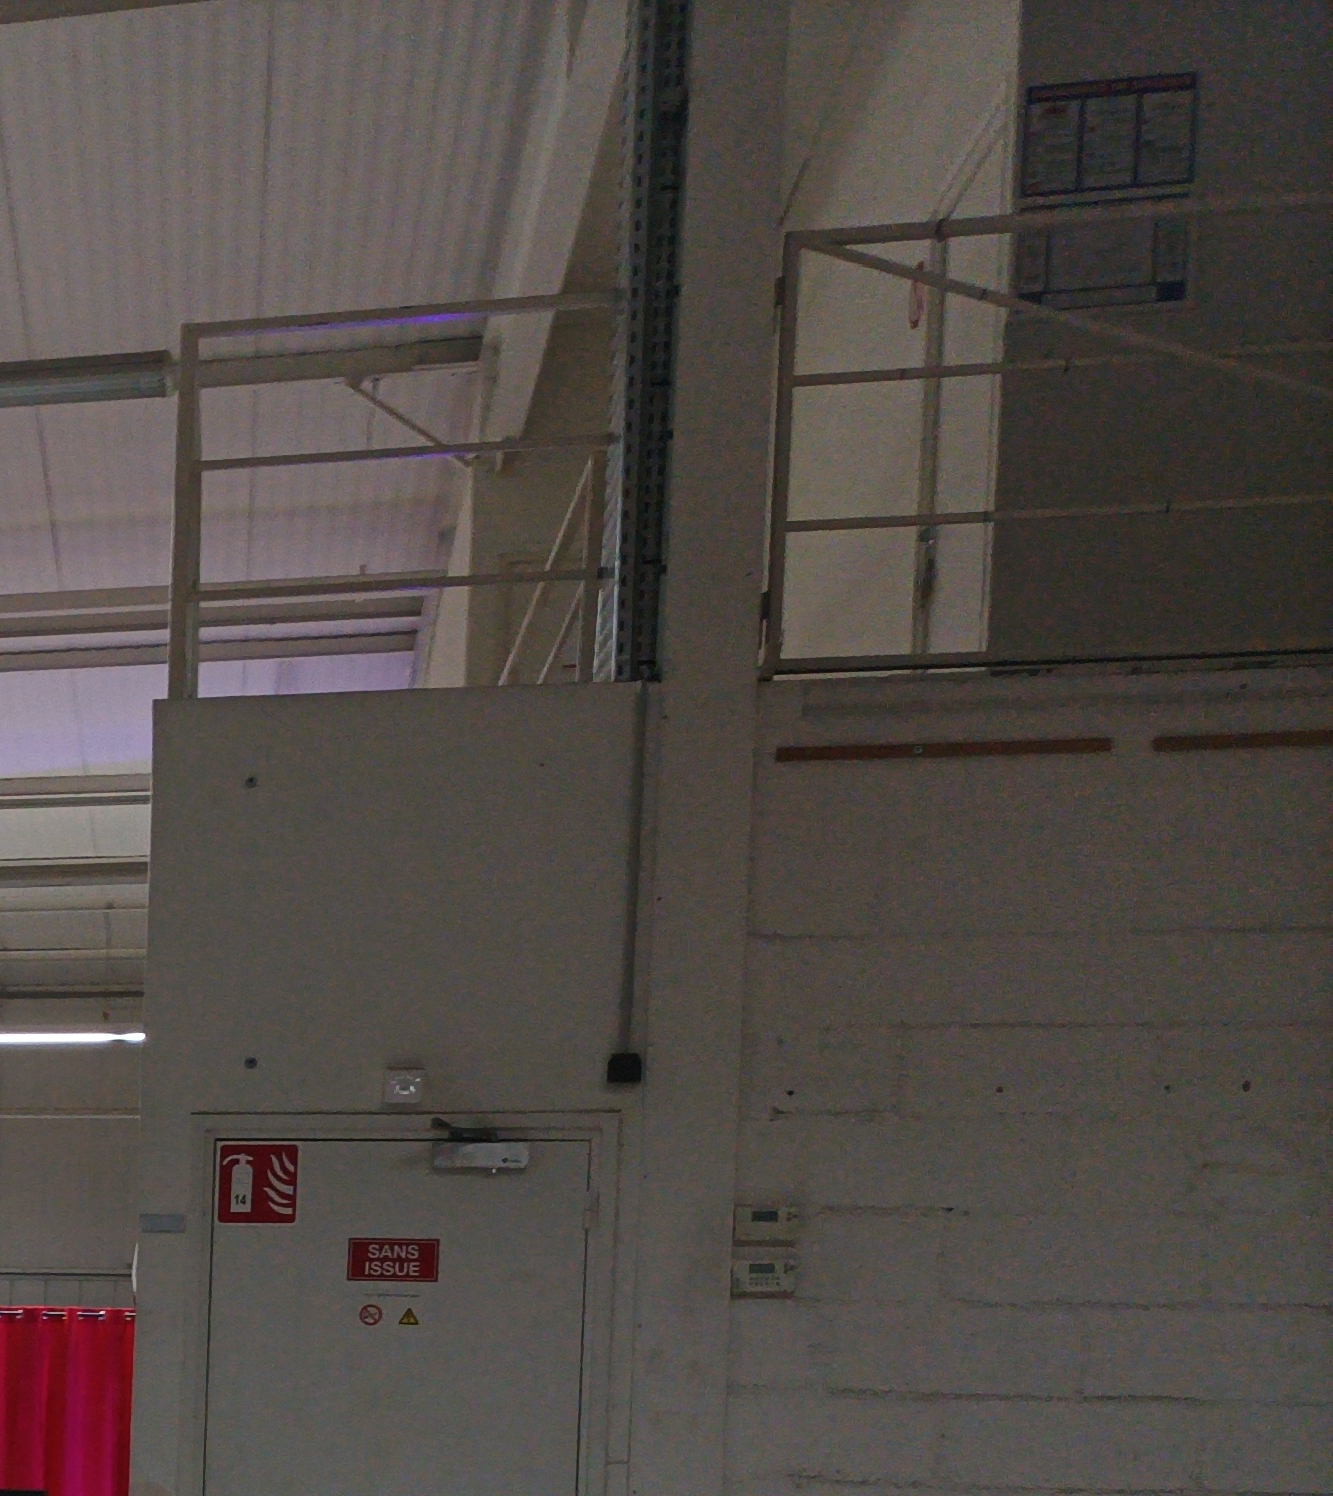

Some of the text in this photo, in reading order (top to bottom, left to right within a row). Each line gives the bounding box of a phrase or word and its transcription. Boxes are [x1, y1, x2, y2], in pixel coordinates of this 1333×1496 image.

[234, 1194, 247, 1206] 14
[367, 1244, 420, 1260] SANS
[364, 1261, 421, 1277] ISSUE
